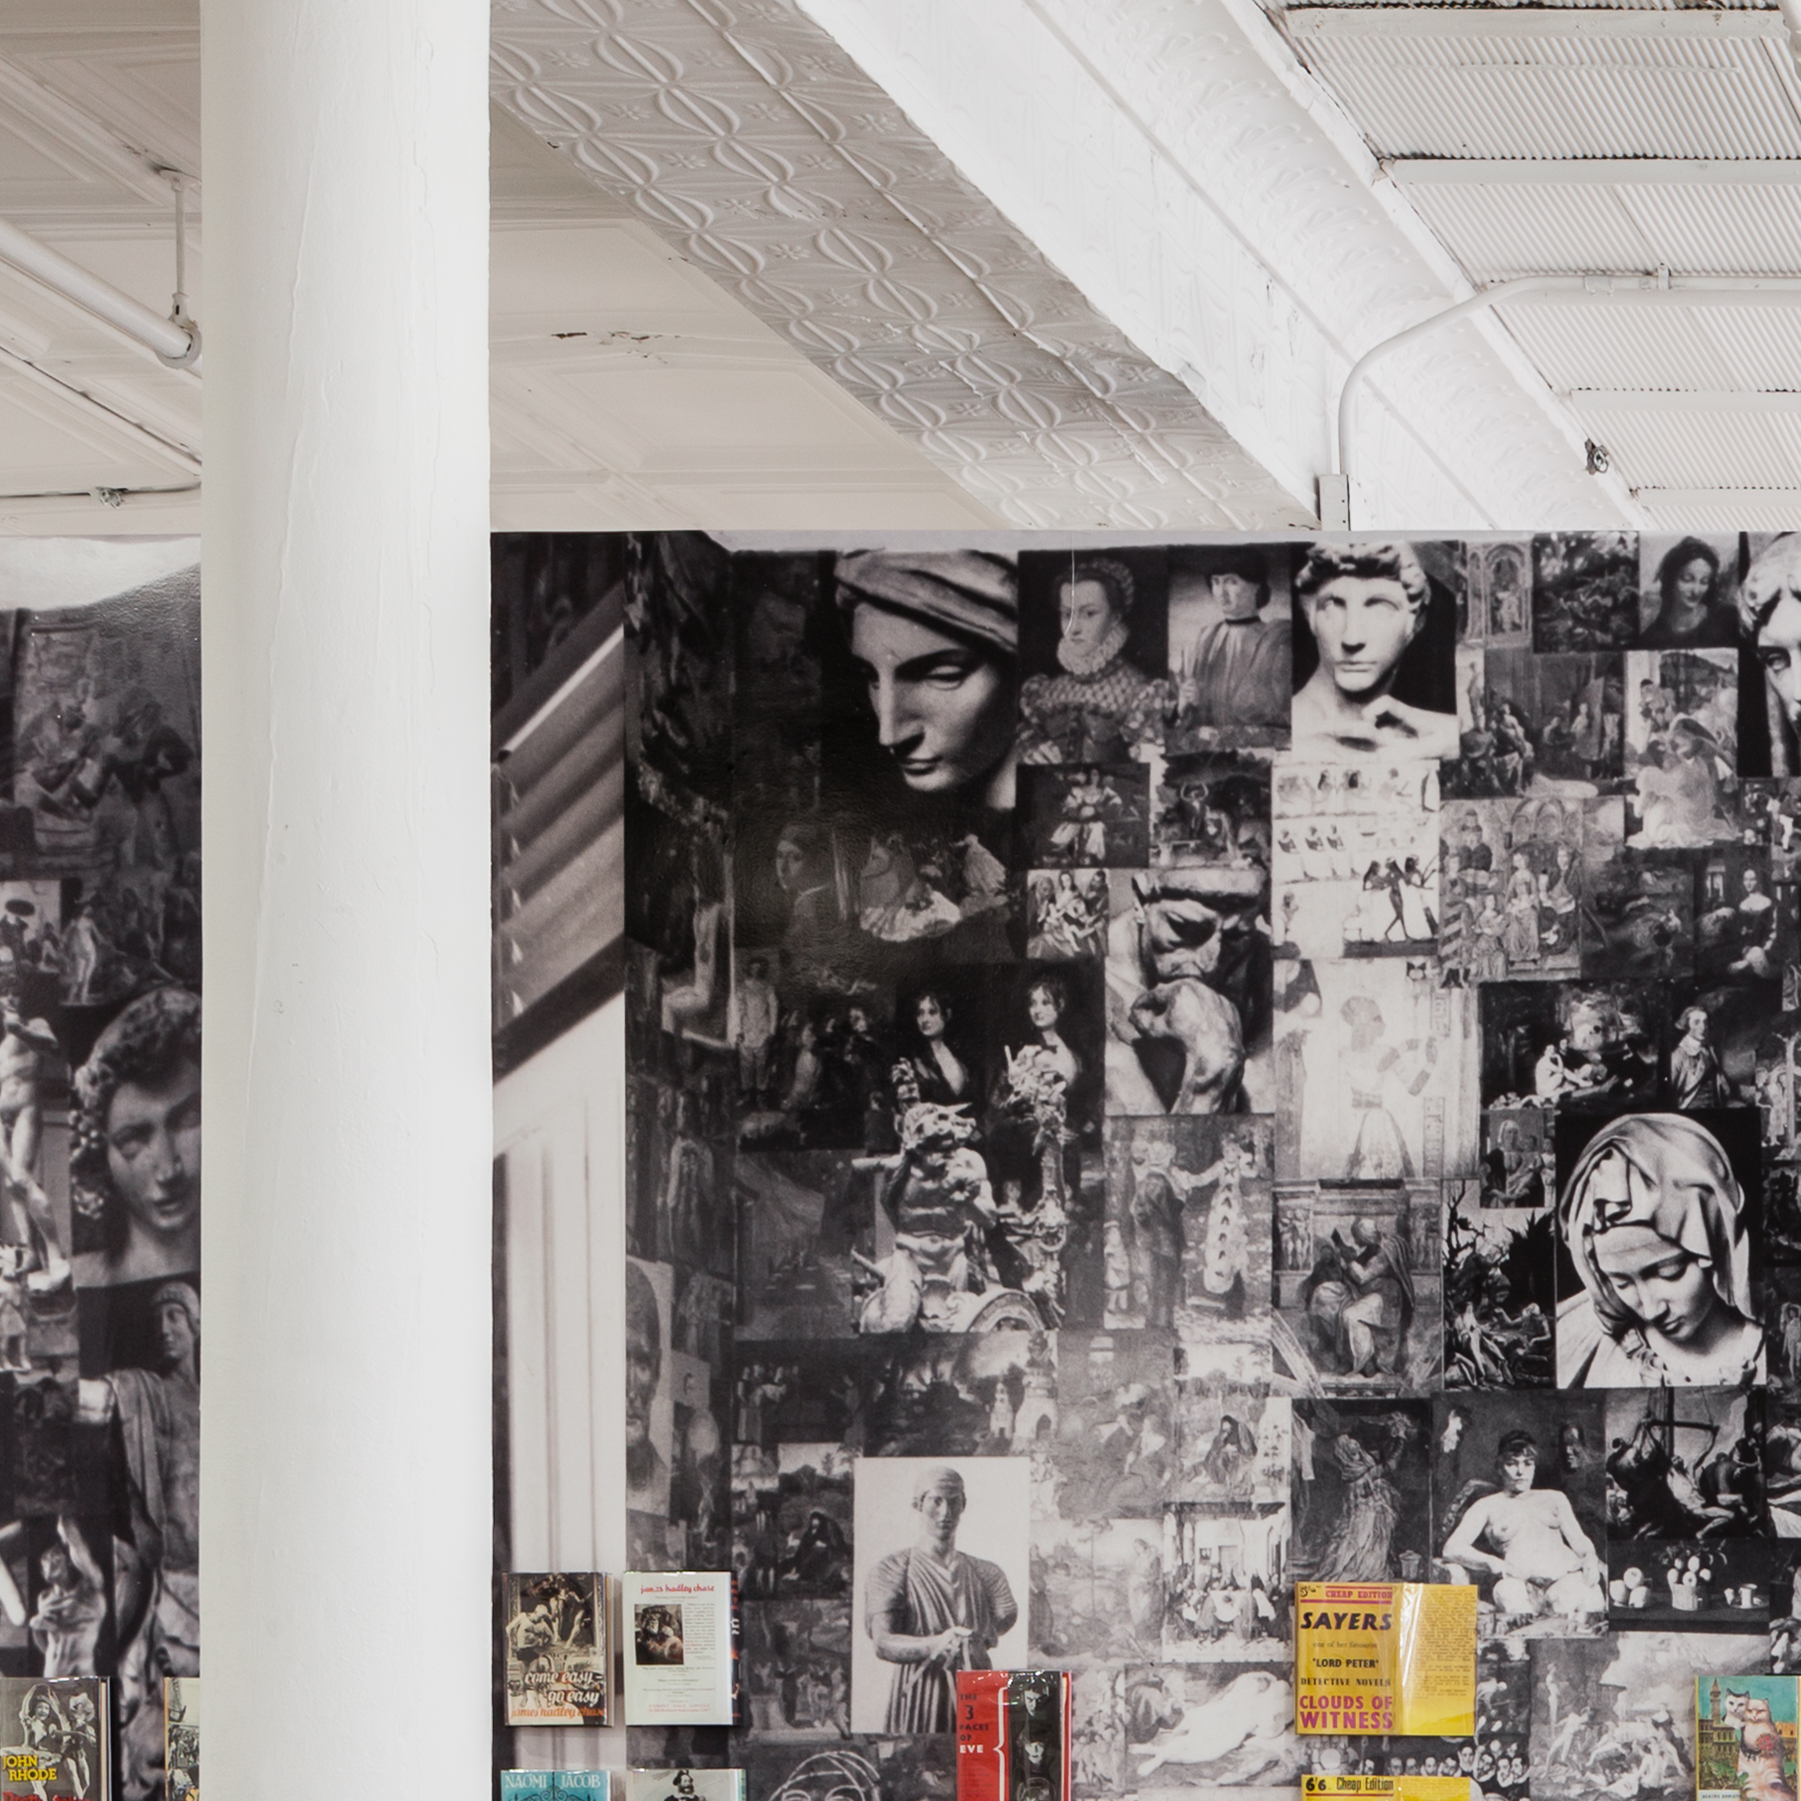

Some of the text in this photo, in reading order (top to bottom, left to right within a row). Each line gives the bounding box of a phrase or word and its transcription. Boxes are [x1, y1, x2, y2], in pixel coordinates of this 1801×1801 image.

[1325, 1590, 1393, 1599] CHEAP EDITION
[1300, 1612, 1393, 1630] SAYERS
[524, 1671, 558, 1685] come
[561, 1671, 593, 1689] easy
[1301, 1677, 1391, 1687] DETECTIVE NOVELS
[548, 1691, 600, 1708] go easy
[1299, 1695, 1393, 1710] CLOUDS OF
[511, 1706, 539, 1719] james
[541, 1707, 576, 1719] hadley
[965, 1704, 974, 1720] 3
[959, 1723, 989, 1731] FACES
[1300, 1711, 1393, 1729] WITNESS
[959, 1745, 984, 1754] EVE
[2, 1755, 38, 1770] JOHN
[8, 1768, 57, 1781] RHODE
[505, 1774, 601, 1789] NAOMI JACOB
[1336, 1777, 1361, 1793] Cheap
[1365, 1777, 1394, 1791] Edition
